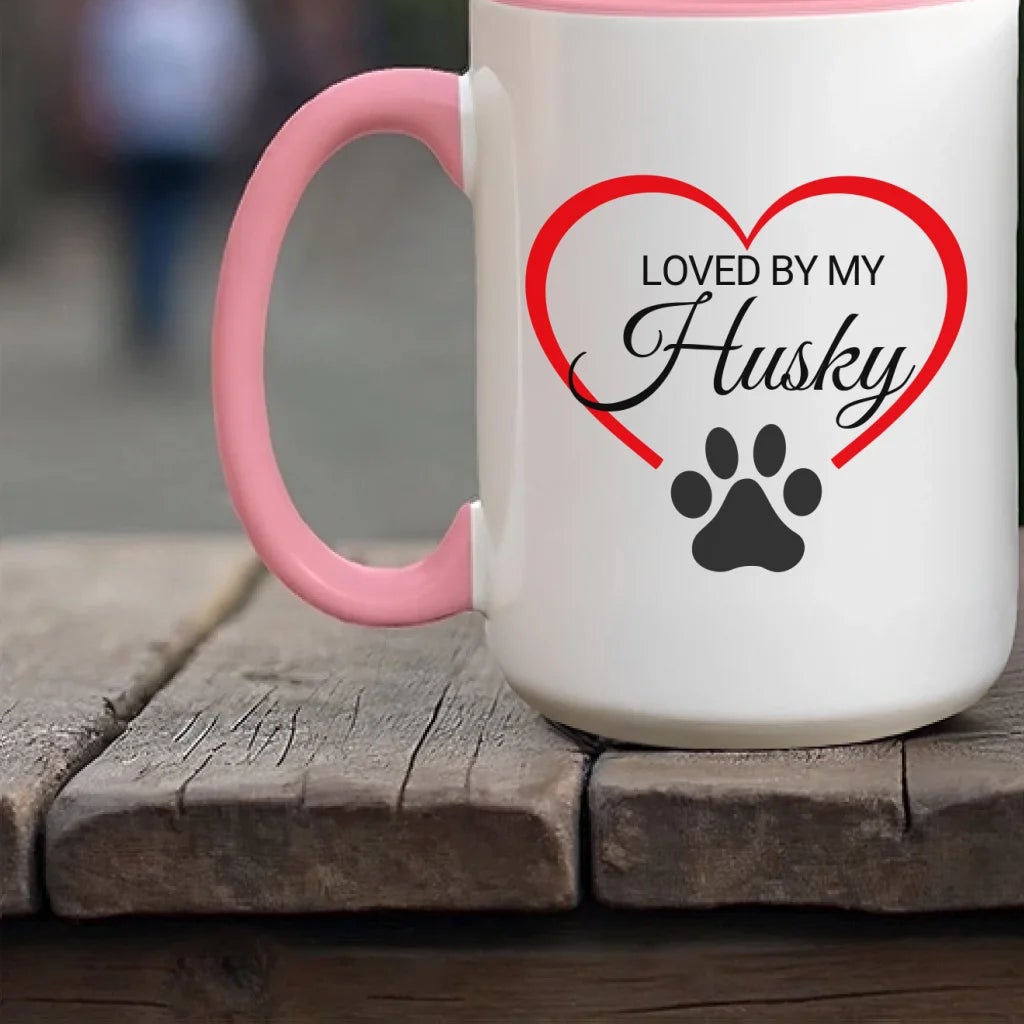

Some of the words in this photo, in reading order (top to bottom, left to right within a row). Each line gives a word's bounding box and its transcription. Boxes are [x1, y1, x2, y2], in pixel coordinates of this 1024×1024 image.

[642, 254, 760, 286] LOVED
[772, 254, 819, 286] BY
[828, 254, 885, 286] MY
[568, 290, 916, 430] Husky
